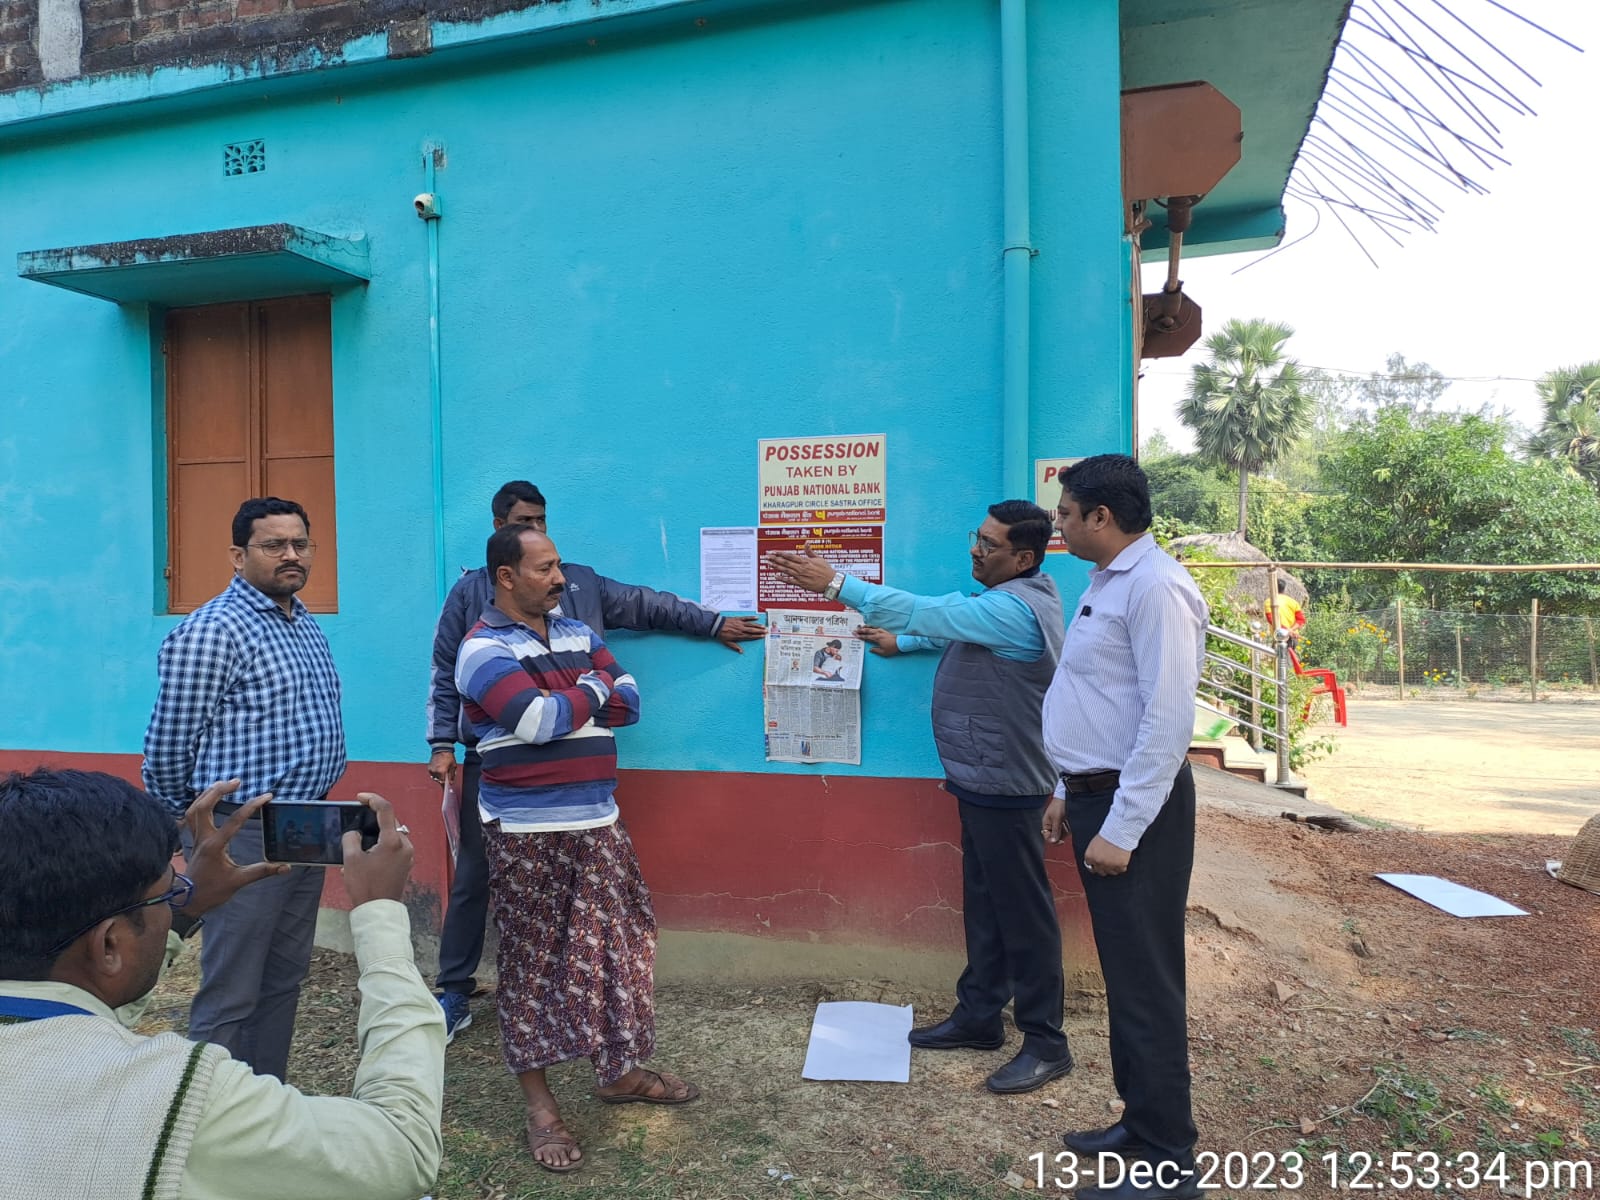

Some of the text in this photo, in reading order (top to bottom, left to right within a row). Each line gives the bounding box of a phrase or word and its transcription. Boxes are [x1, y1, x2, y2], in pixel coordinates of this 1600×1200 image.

[765, 441, 879, 461] POSSESSION
[786, 464, 858, 478] TAKEN BY
[764, 482, 881, 497] PUNJAB NATIONAL BANK
[830, 499, 857, 507] SASTRA
[858, 498, 882, 506] OFFICE
[825, 614, 849, 627] পত্রিকা
